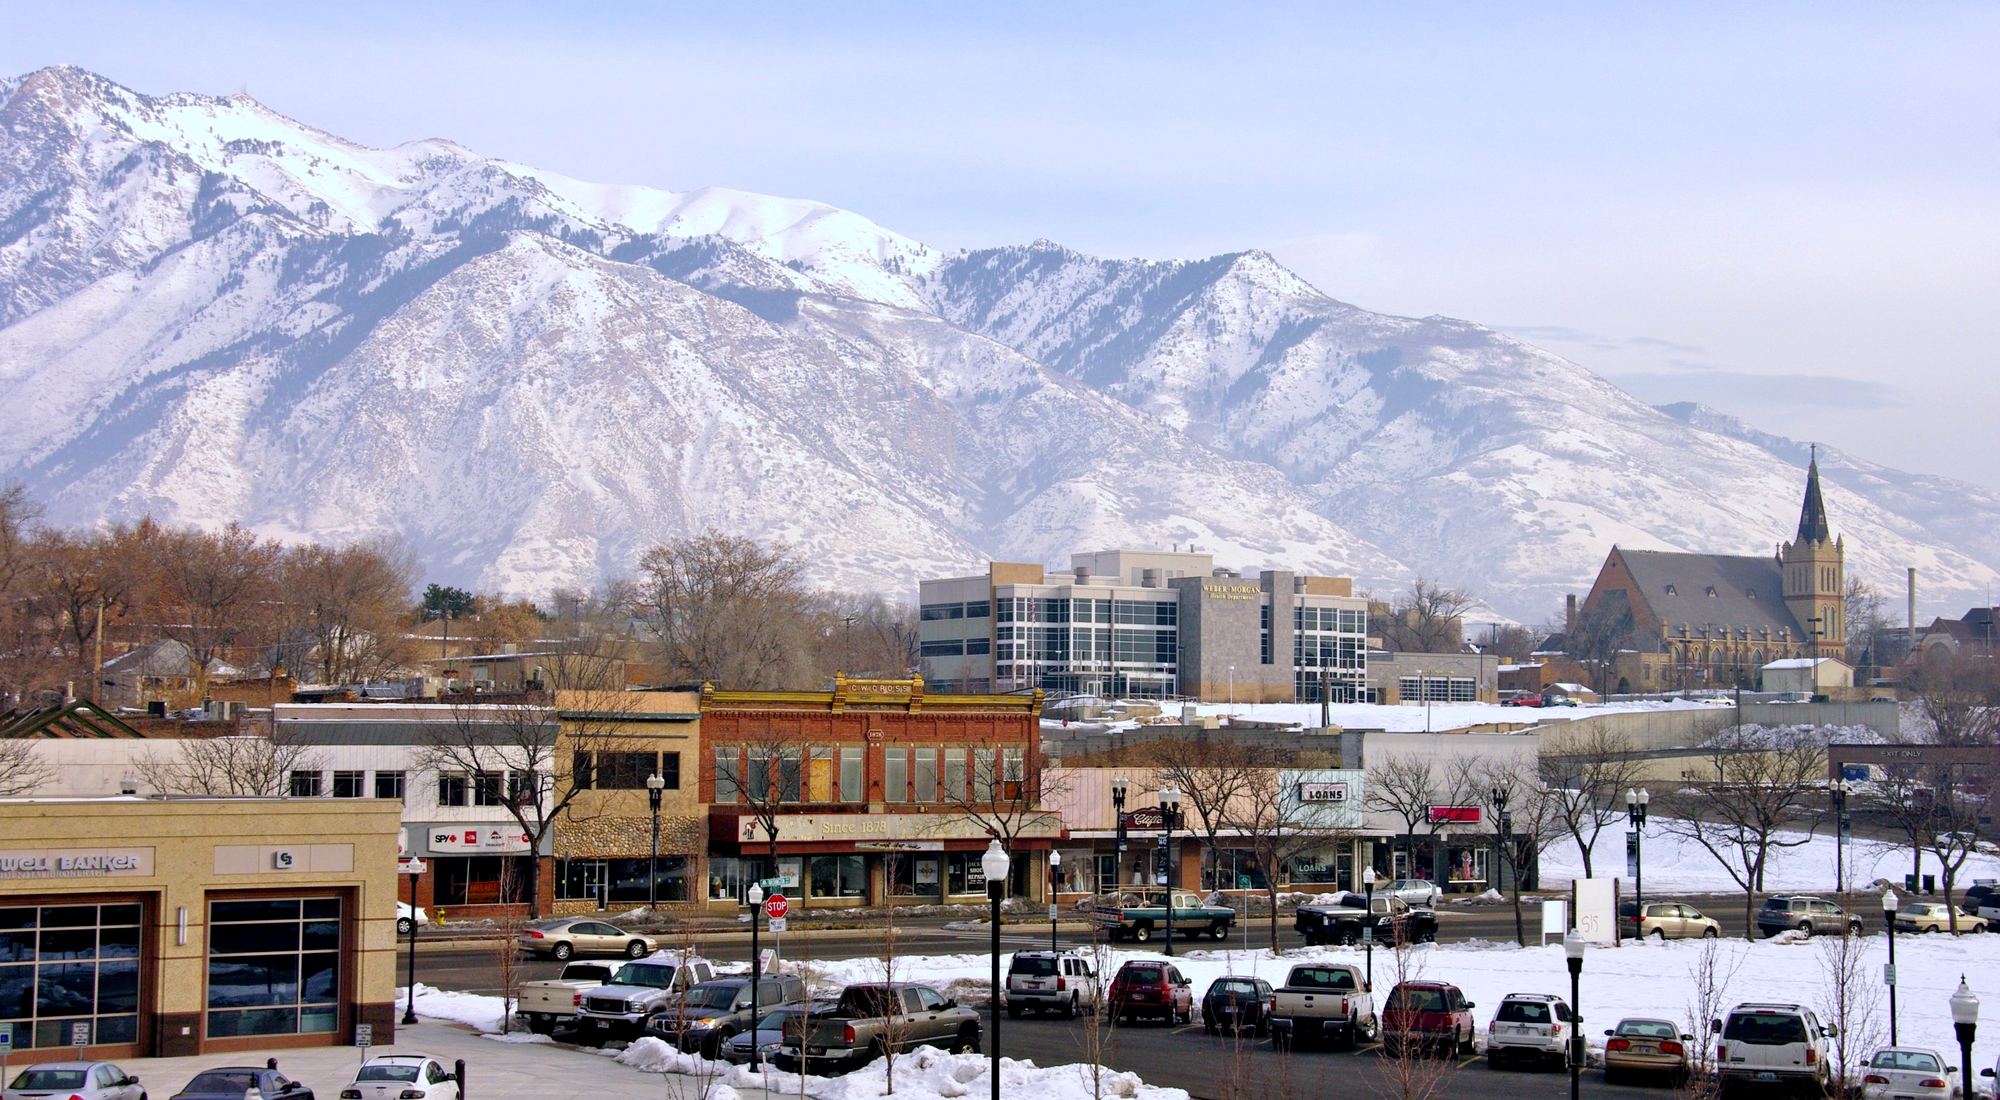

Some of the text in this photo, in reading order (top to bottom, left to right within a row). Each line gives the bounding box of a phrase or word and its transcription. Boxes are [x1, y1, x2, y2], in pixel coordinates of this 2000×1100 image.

[1203, 584, 1261, 594] WEBER MORGAN
[872, 684, 908, 693] CROSS
[1881, 750, 1922, 758] EXIT ONLY
[1309, 790, 1343, 799] LOANS
[822, 820, 887, 833] Since 1878
[435, 834, 450, 844] SPY
[59, 856, 138, 872] BANKER
[1298, 864, 1327, 872] LOANS
[767, 901, 787, 912] STOP
